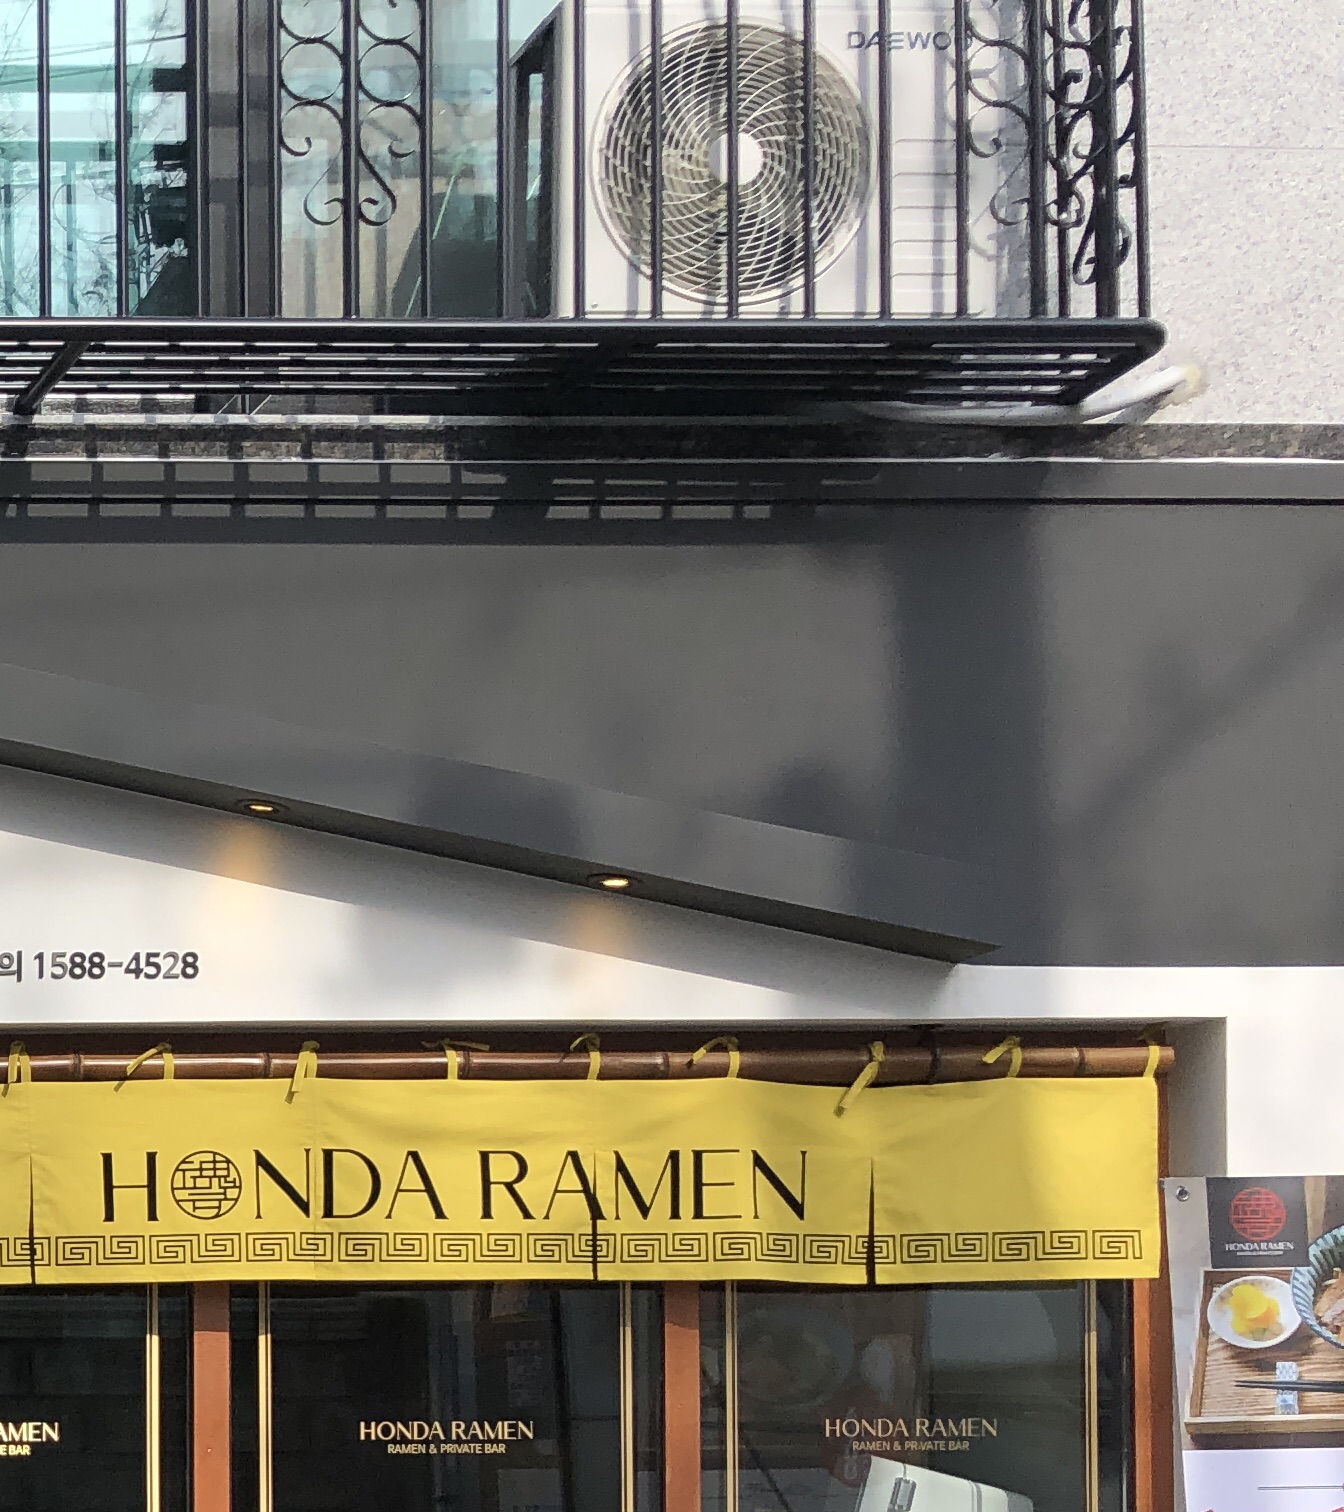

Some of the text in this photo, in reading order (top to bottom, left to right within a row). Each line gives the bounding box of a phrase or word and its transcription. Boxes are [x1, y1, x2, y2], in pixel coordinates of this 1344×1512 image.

[847, 31, 973, 50] DAEWO
[33, 951, 200, 980] 1588-4528
[477, 1148, 808, 1222] RAMEN
[1225, 1242, 1259, 1251] HONDA
[359, 1420, 534, 1441] HONDA RAMEN
[825, 1417, 998, 1438] HONDA RAMEN
[8, 1444, 31, 1456] BAR
[387, 1443, 506, 1454] RAMEN & PRIVATE BAR
[852, 1440, 970, 1451] RAMEN & PRIVATE BAR
